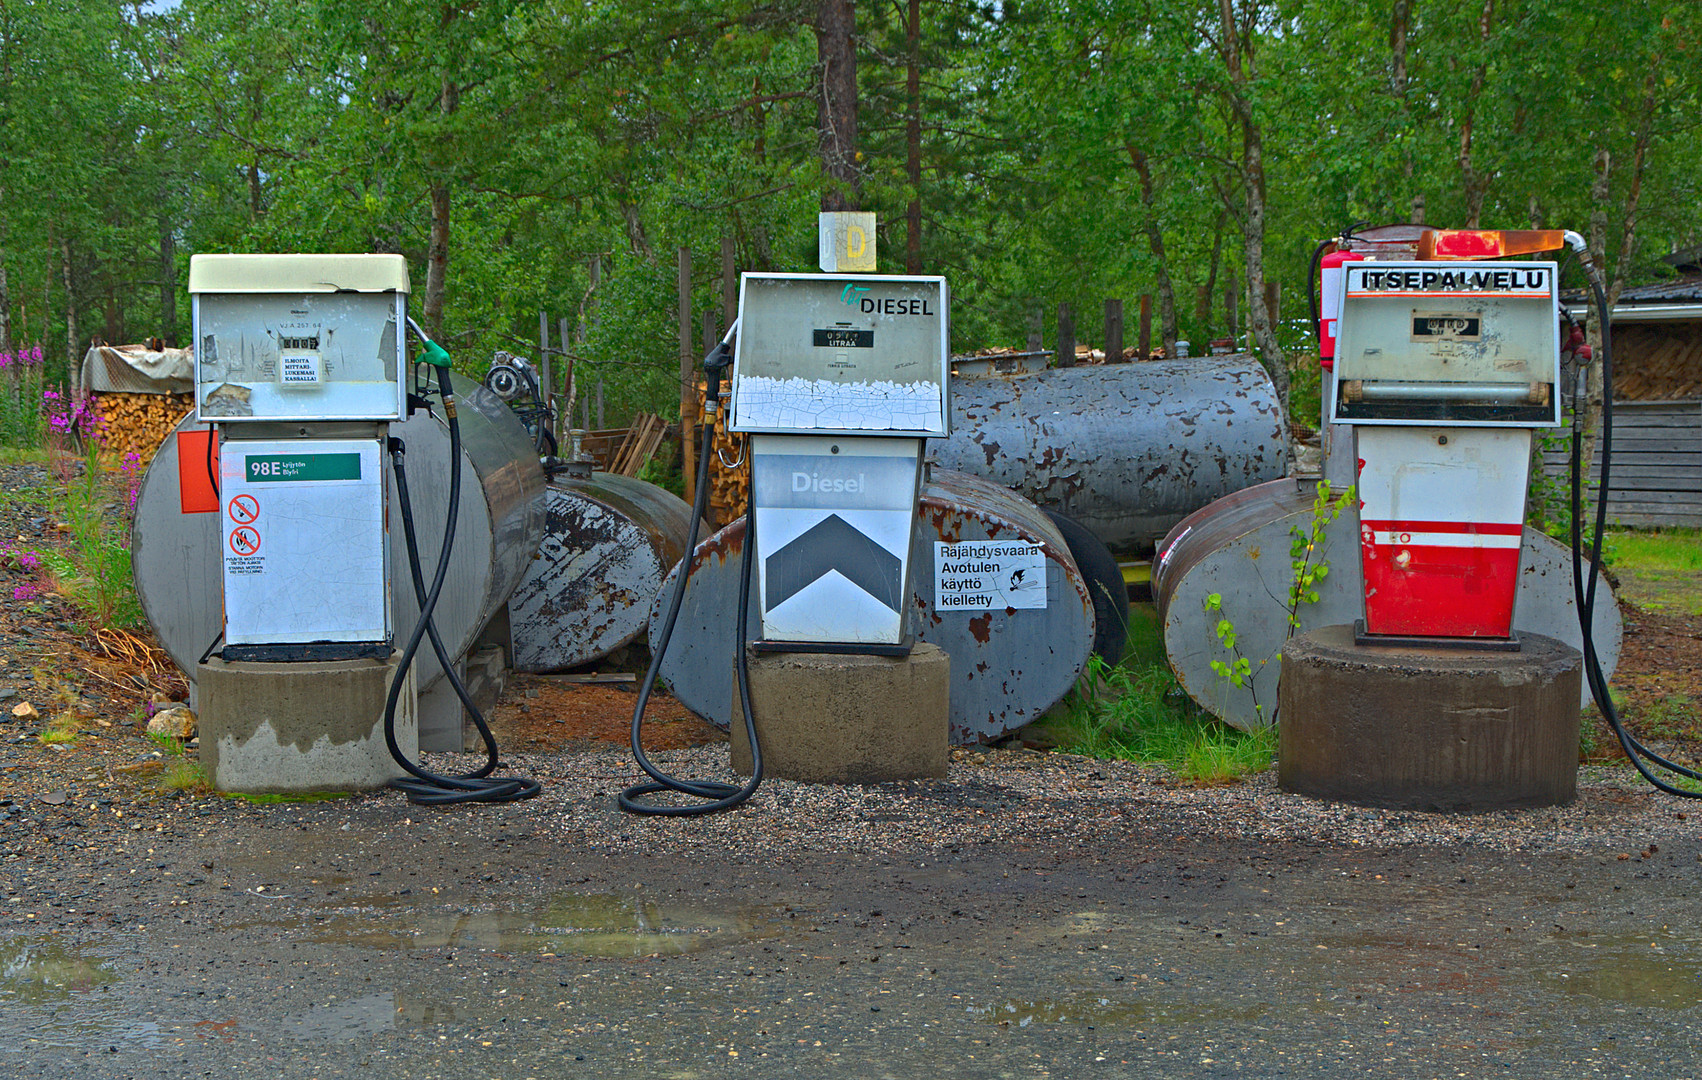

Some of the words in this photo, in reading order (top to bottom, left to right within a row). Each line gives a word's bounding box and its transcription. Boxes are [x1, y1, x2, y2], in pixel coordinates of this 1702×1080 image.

[847, 225, 866, 258] D
[860, 298, 934, 316] DIESEL
[251, 461, 281, 476] 98E
[791, 472, 865, 494] Diesel
[940, 545, 1038, 560] Räjähdysvaara
[941, 562, 1001, 574] Avotulen
[941, 577, 982, 592] käyttö
[941, 594, 993, 608] kielletty
